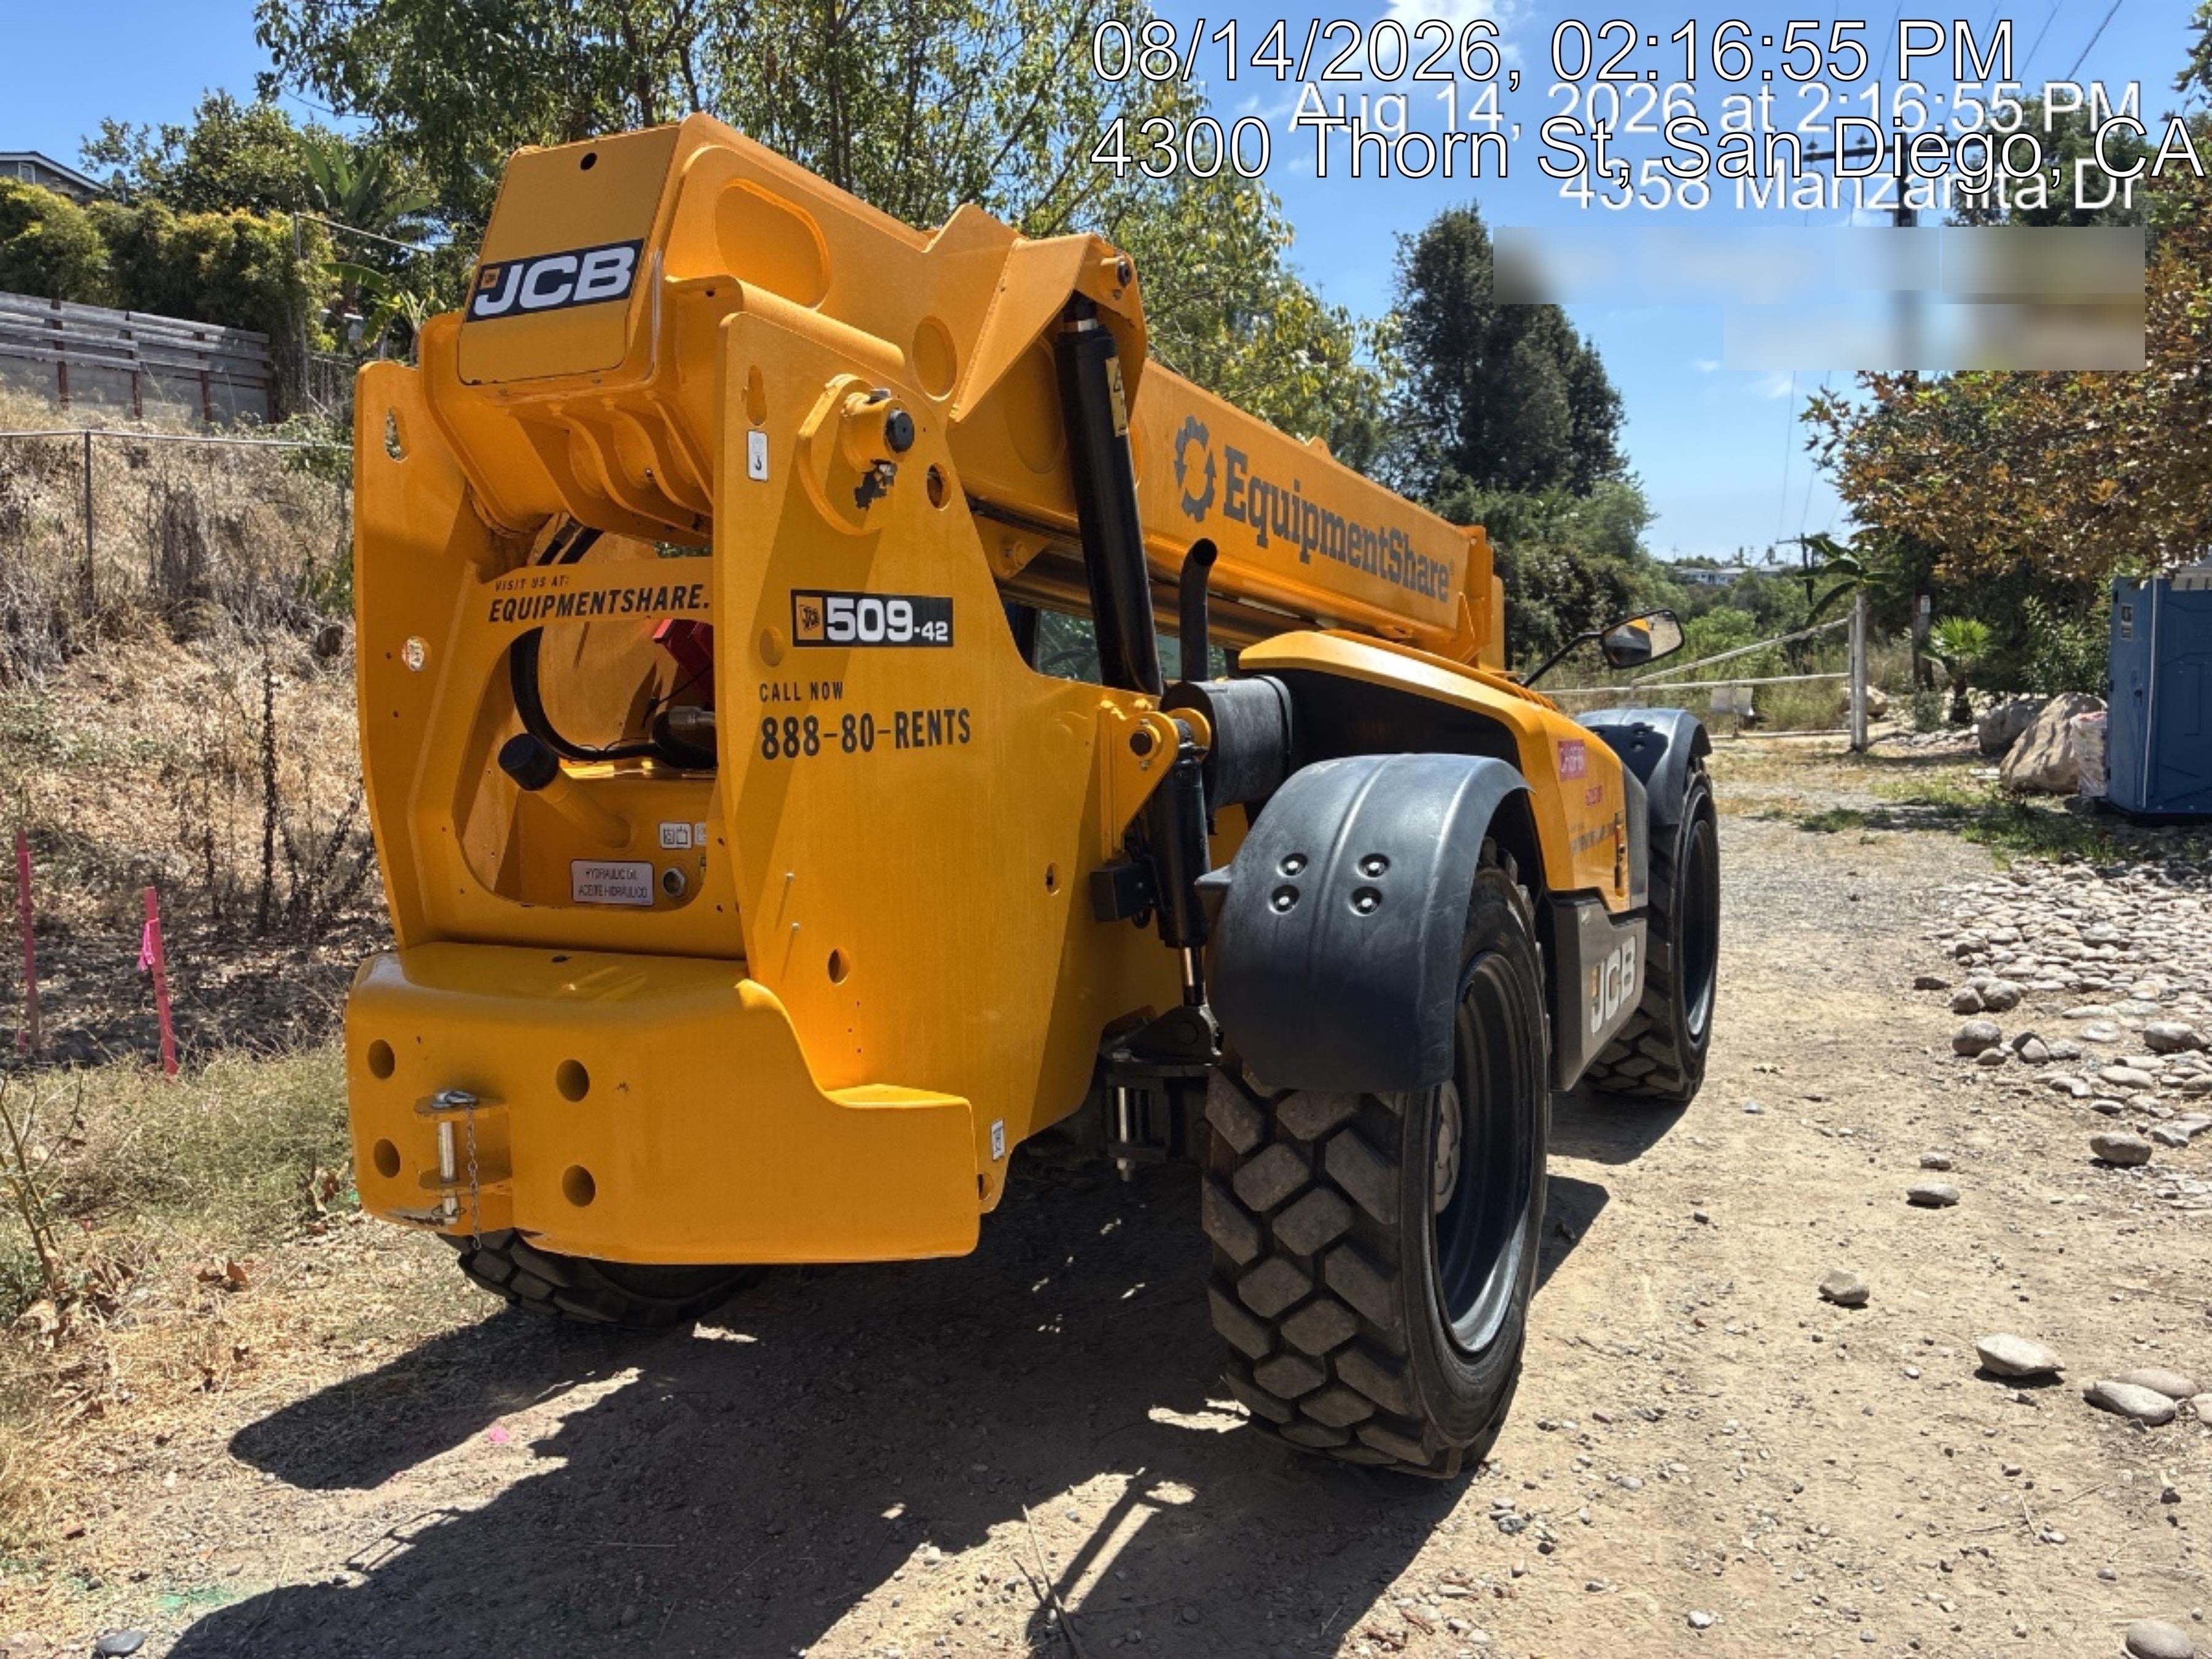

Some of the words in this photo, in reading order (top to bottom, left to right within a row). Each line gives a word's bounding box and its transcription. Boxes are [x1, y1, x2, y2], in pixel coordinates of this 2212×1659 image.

[473, 246, 635, 316] JCB
[1223, 445, 1449, 603] EquipmentShare
[488, 584, 709, 622] EQUIPMENTSHARE.
[495, 578, 527, 592] VISIT
[531, 576, 546, 589] US
[551, 575, 570, 587] AT:
[759, 682, 802, 702] CALL
[810, 681, 844, 700] NOW
[761, 708, 970, 759] 888-80-RENTS
[1591, 936, 1636, 1035] JCB
